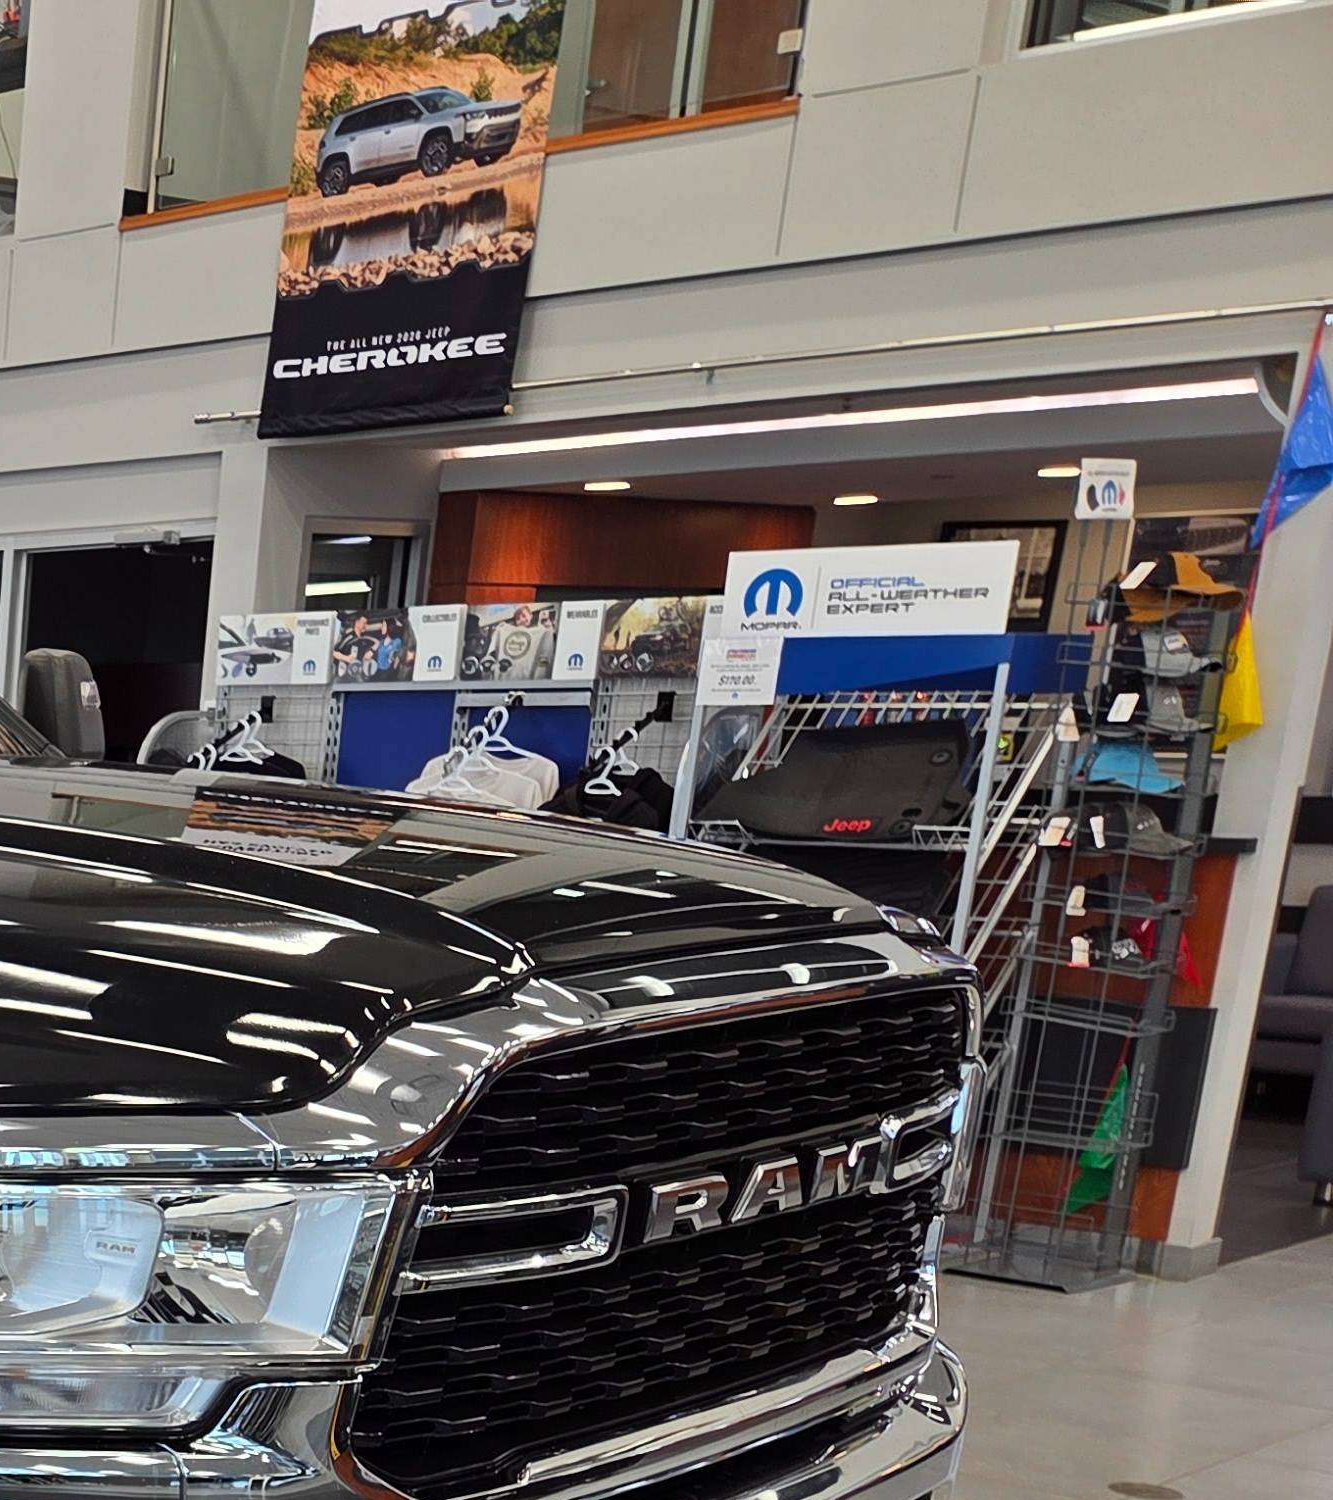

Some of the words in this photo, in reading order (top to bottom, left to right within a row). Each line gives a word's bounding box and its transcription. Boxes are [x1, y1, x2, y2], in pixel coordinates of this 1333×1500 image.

[326, 340, 346, 352] THE
[349, 338, 367, 349] ALL
[371, 334, 393, 346] NEW
[396, 330, 421, 343] 2026
[425, 325, 451, 339] JEEP
[273, 333, 507, 379] CHEROKEE
[830, 576, 925, 589] OFFICIAL
[828, 587, 990, 602] ALL-WEATHER
[826, 602, 915, 615] EXPERT
[822, 818, 872, 833] Jeep
[643, 1137, 883, 1244] RAM
[96, 1241, 136, 1254] RAM
